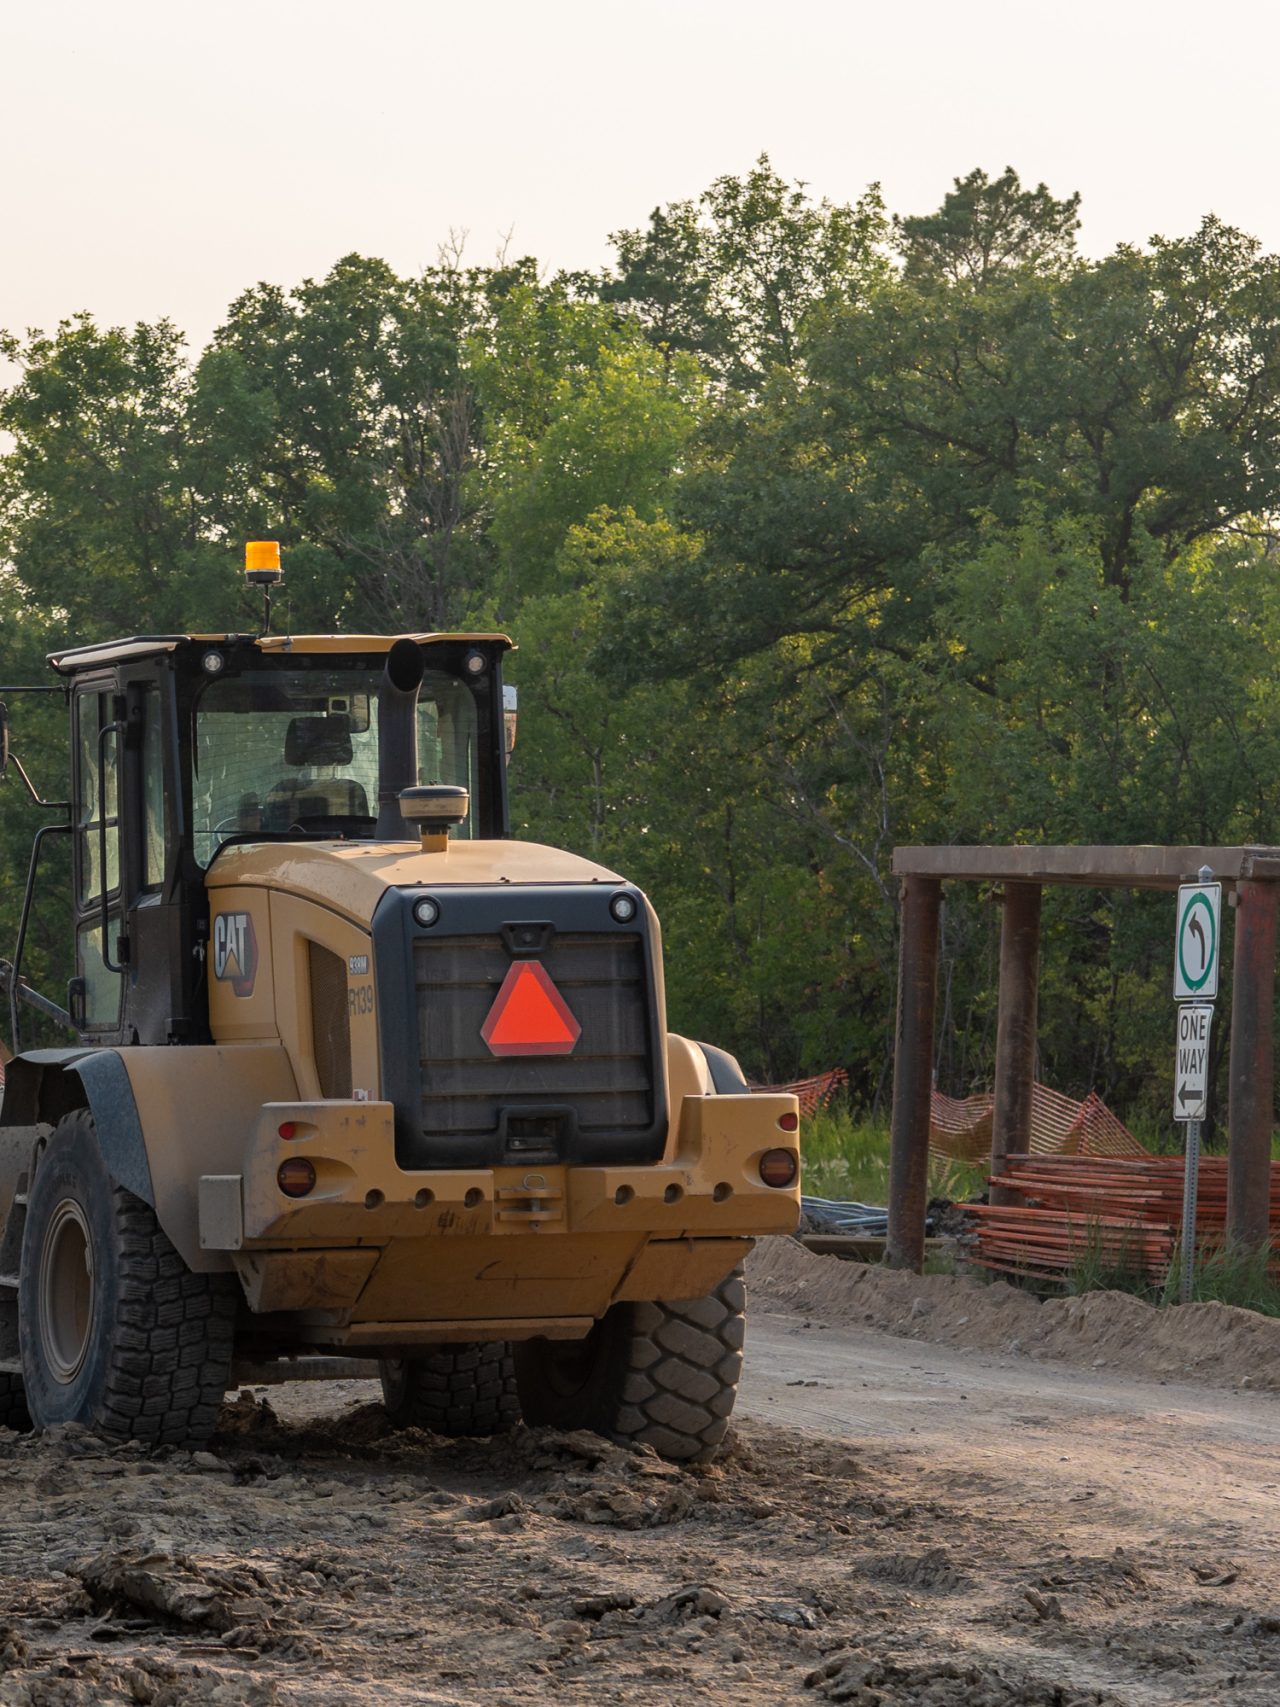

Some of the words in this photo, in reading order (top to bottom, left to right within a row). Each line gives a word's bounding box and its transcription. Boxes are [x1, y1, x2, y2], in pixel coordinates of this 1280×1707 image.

[214, 914, 248, 978] CAT
[349, 985, 373, 1016] R139
[1180, 1014, 1206, 1041] ONE
[1179, 1048, 1206, 1075] WAY
